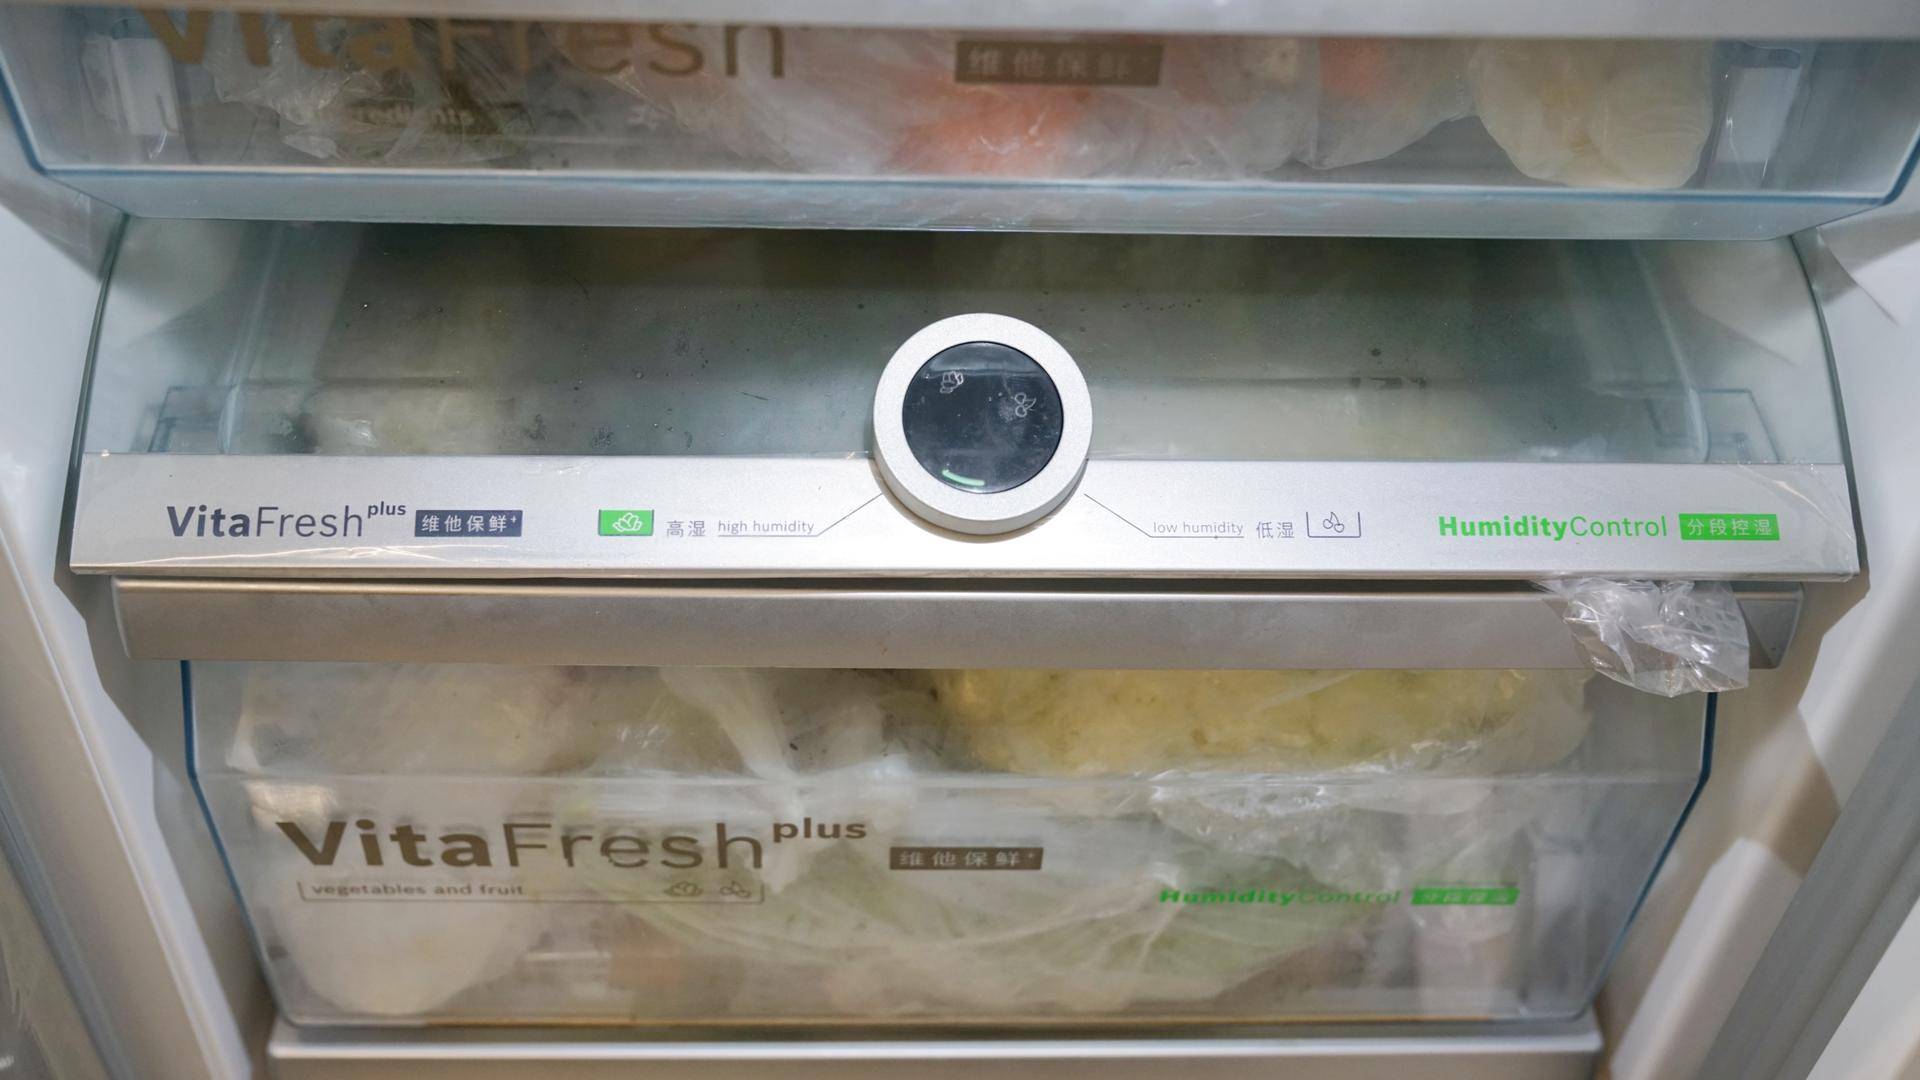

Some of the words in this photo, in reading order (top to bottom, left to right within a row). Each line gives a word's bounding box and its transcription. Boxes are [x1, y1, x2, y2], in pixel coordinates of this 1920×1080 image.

[166, 505, 363, 538] VitaFresh
[368, 501, 406, 519] plus
[718, 520, 748, 535] high
[753, 520, 815, 535] humidity
[1153, 521, 1178, 534] low
[1183, 521, 1244, 536] humidity
[1438, 515, 1667, 541] HumidityControl
[1687, 518, 1774, 536] 分段控湿
[666, 520, 706, 538] 高湿
[1256, 521, 1295, 539] 低湿
[276, 819, 763, 869] VitaFresh
[772, 817, 868, 843] plus
[311, 881, 427, 897] vegetables
[433, 881, 473, 896] and
[479, 881, 524, 896] fruit
